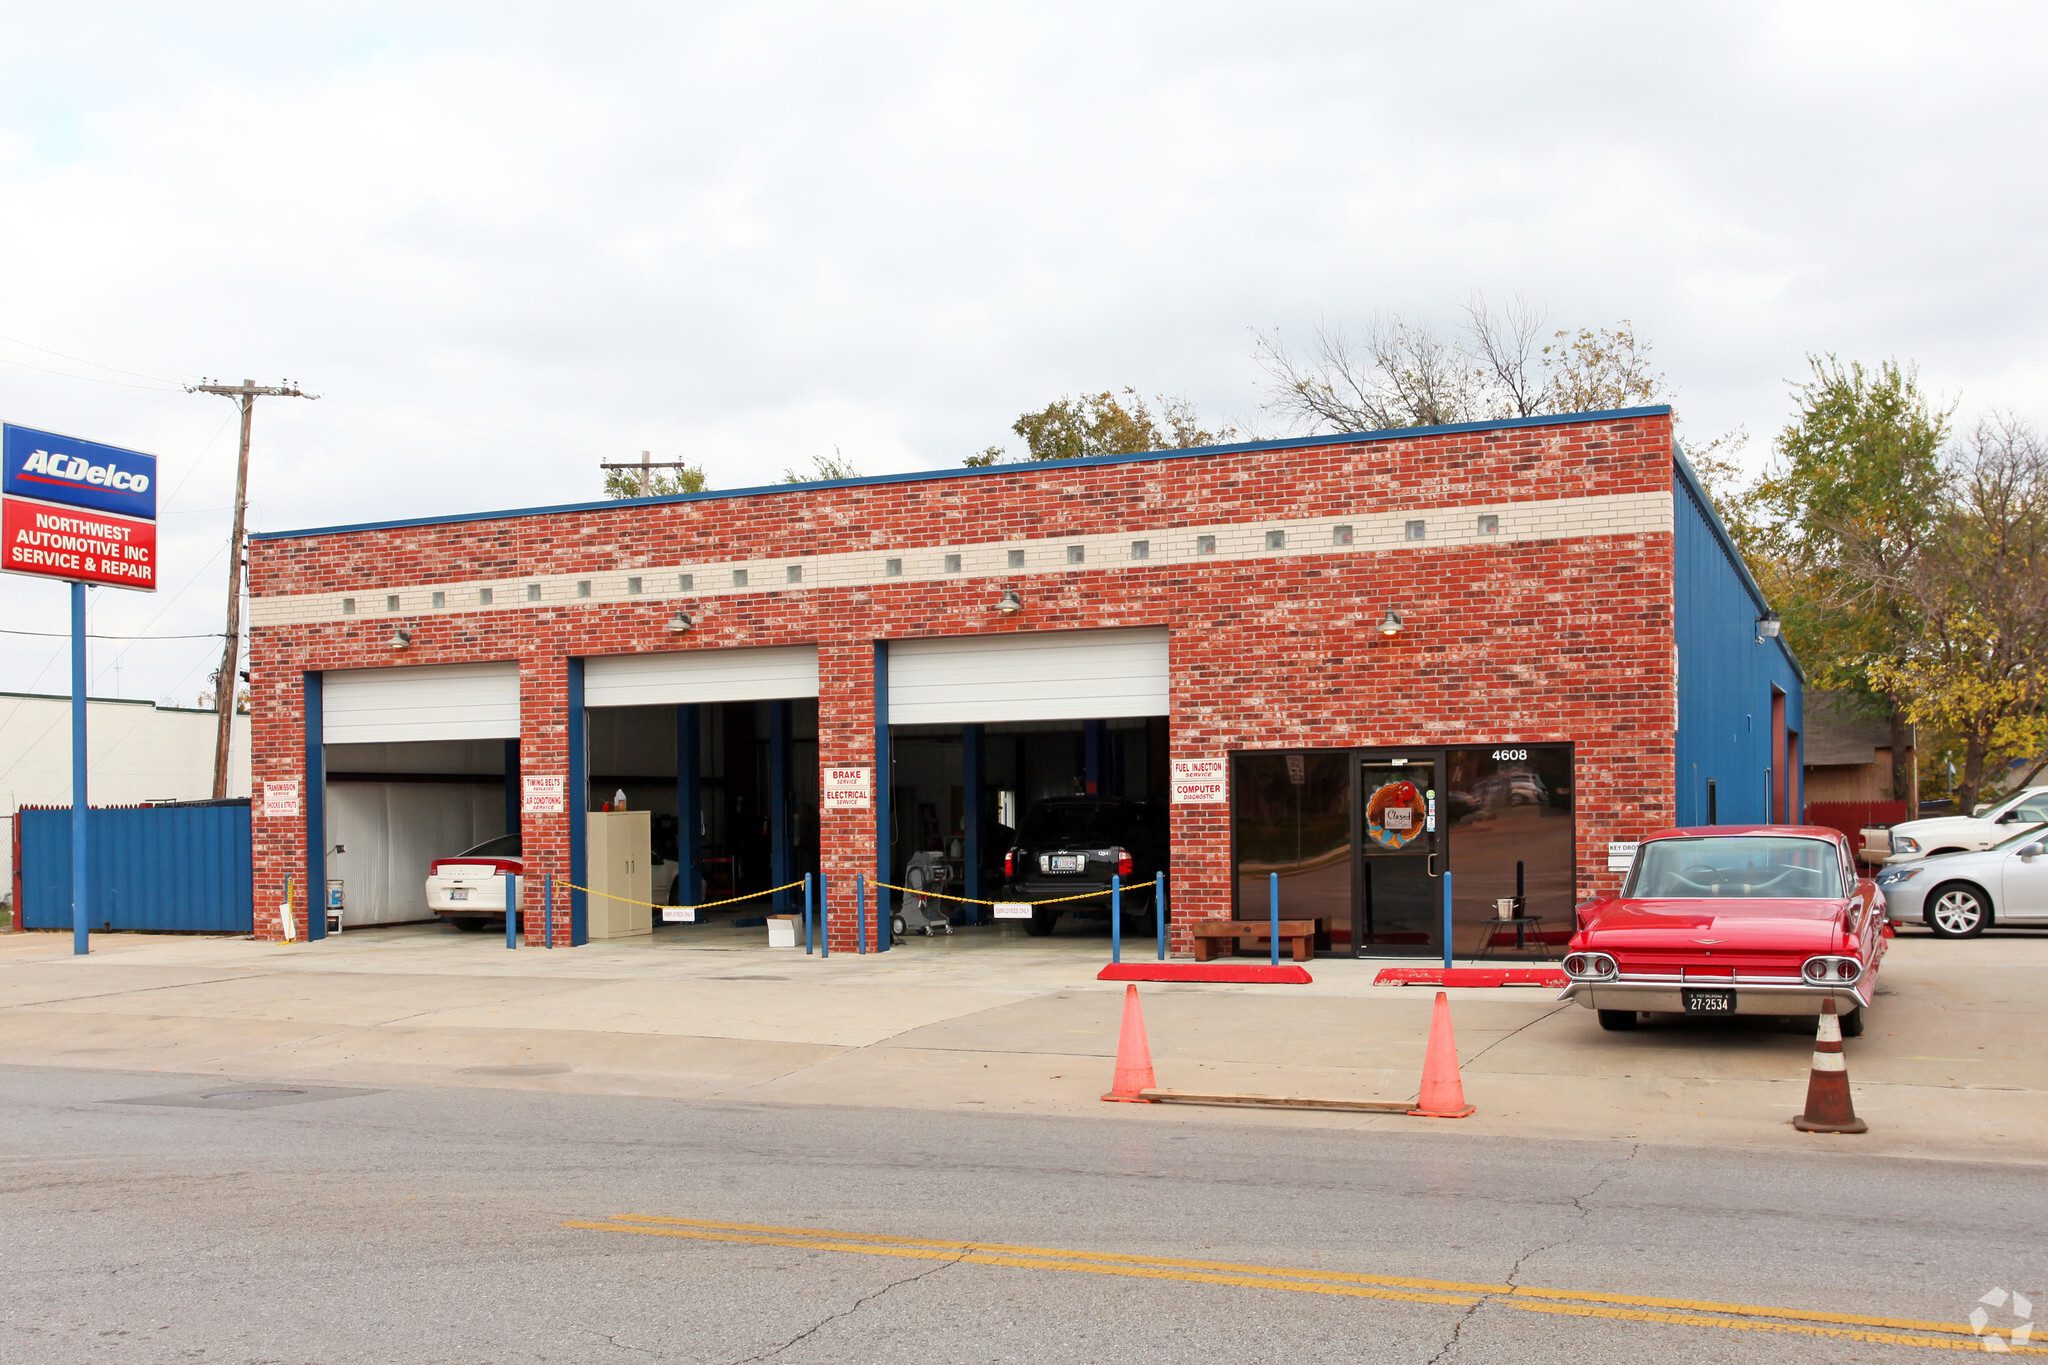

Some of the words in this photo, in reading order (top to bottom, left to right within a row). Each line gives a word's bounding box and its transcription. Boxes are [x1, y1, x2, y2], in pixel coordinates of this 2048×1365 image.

[22, 449, 149, 493] ACDelco
[36, 513, 131, 541] NORTHWEST
[16, 529, 120, 557] AUTOMOTIVE
[124, 545, 149, 562] INC
[12, 547, 80, 569] SERVICE
[84, 557, 96, 572] &
[101, 559, 152, 580] REPAIR
[1492, 749, 1527, 760] 4608
[1176, 763, 1189, 772] FUEL
[1192, 762, 1222, 771] INJECTION
[1177, 784, 1220, 793] COMPUTER
[534, 796, 561, 804] CONDITIONING
[827, 791, 867, 799] ELECTRICAL
[1387, 809, 1411, 820] Closed
